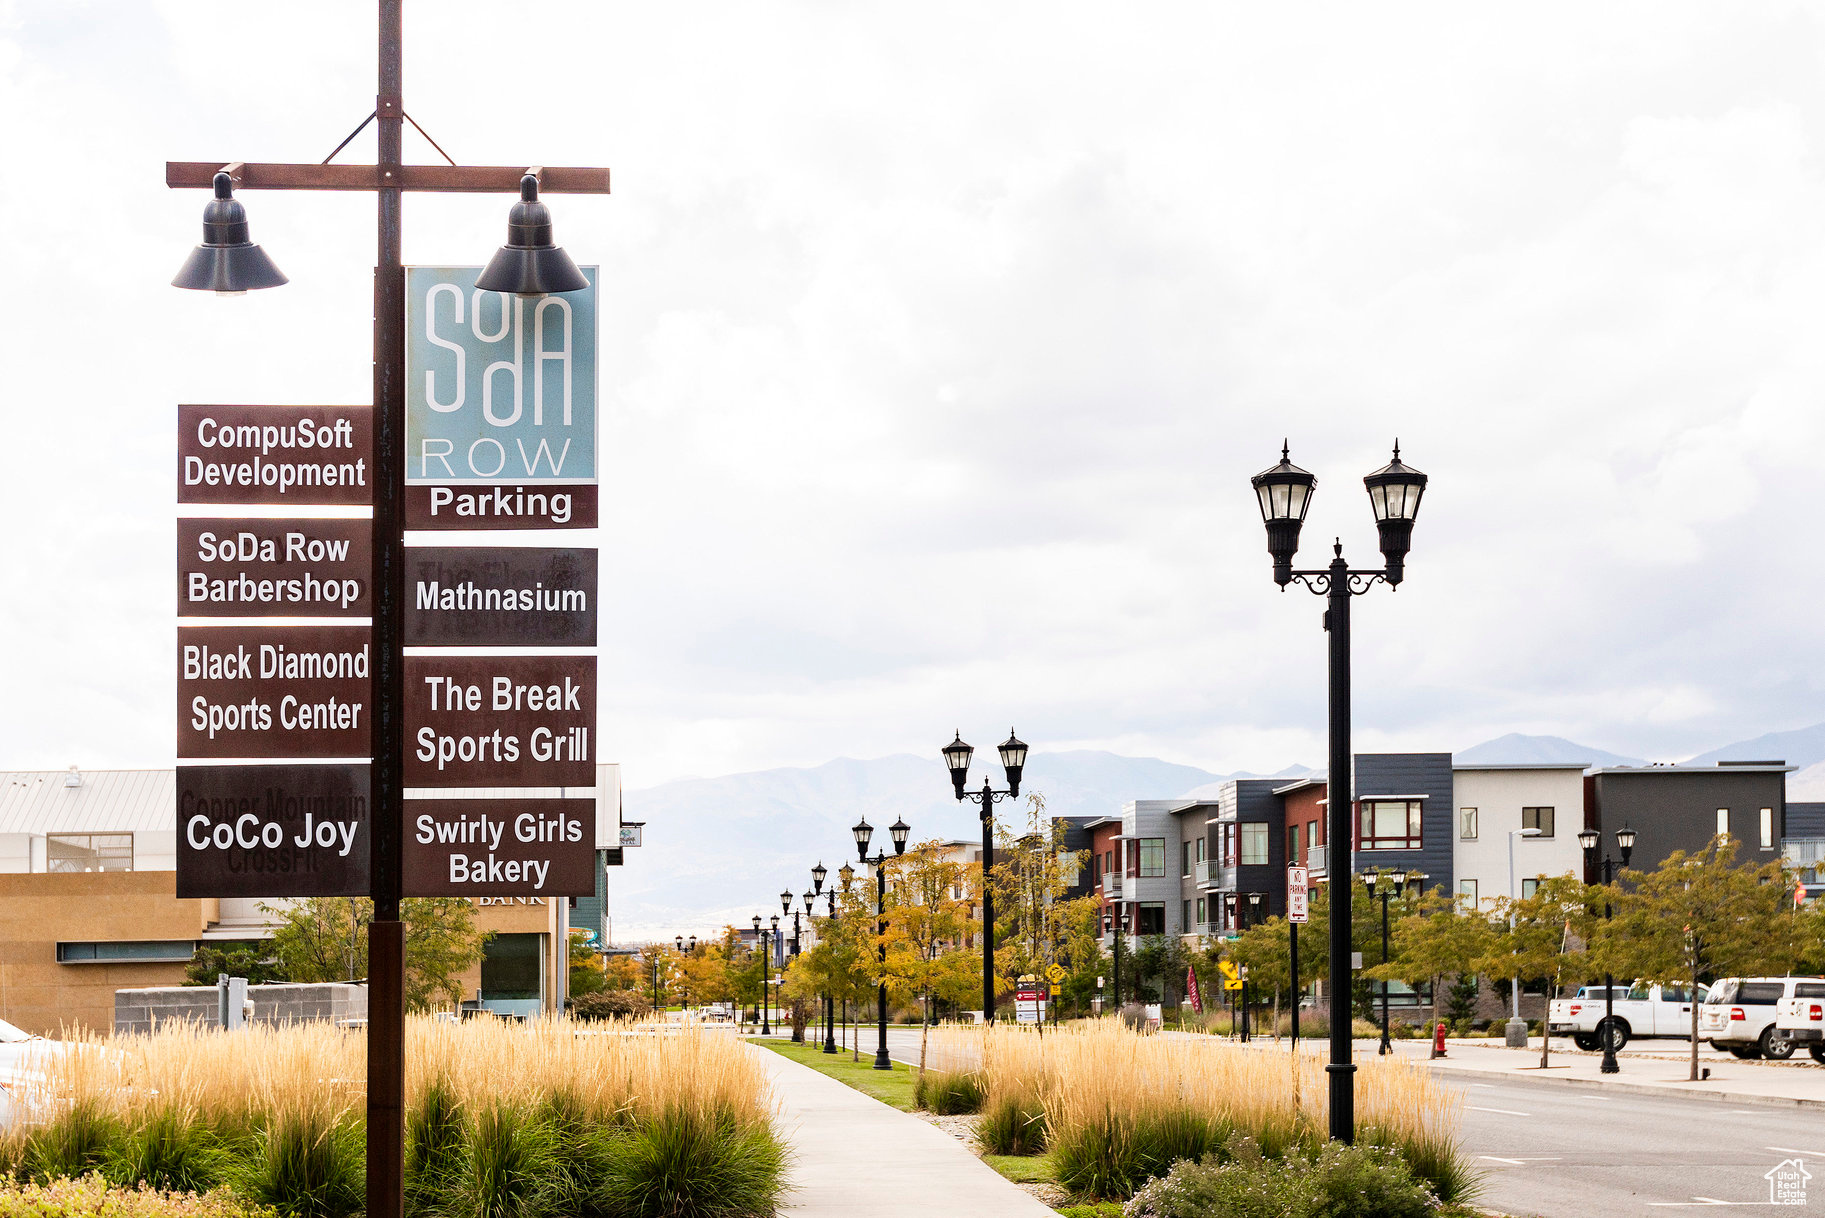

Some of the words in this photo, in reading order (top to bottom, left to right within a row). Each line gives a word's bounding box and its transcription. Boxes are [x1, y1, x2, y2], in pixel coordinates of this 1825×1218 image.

[197, 418, 353, 454] CompuSoft
[184, 456, 366, 493] Development
[421, 438, 571, 477] ROW
[431, 488, 571, 523] Parking
[198, 532, 275, 561] SoDa
[287, 533, 349, 561] Row
[189, 573, 358, 608] Barbershop
[417, 582, 585, 611] Mathnasium
[184, 645, 251, 679] Black
[261, 644, 368, 679] Diamond
[425, 677, 481, 711] The
[493, 677, 580, 710] Break
[192, 696, 271, 739] Sports
[281, 695, 362, 729] Center
[417, 727, 519, 770] Sports
[531, 727, 587, 761] Grill
[187, 814, 282, 850] CoCo
[294, 813, 358, 856] Joy
[415, 814, 505, 850] Swirly
[515, 813, 582, 842] Girls
[449, 854, 550, 889] Bakery
[1290, 884, 1306, 894] PARKING
[1294, 873, 1302, 882] NO
